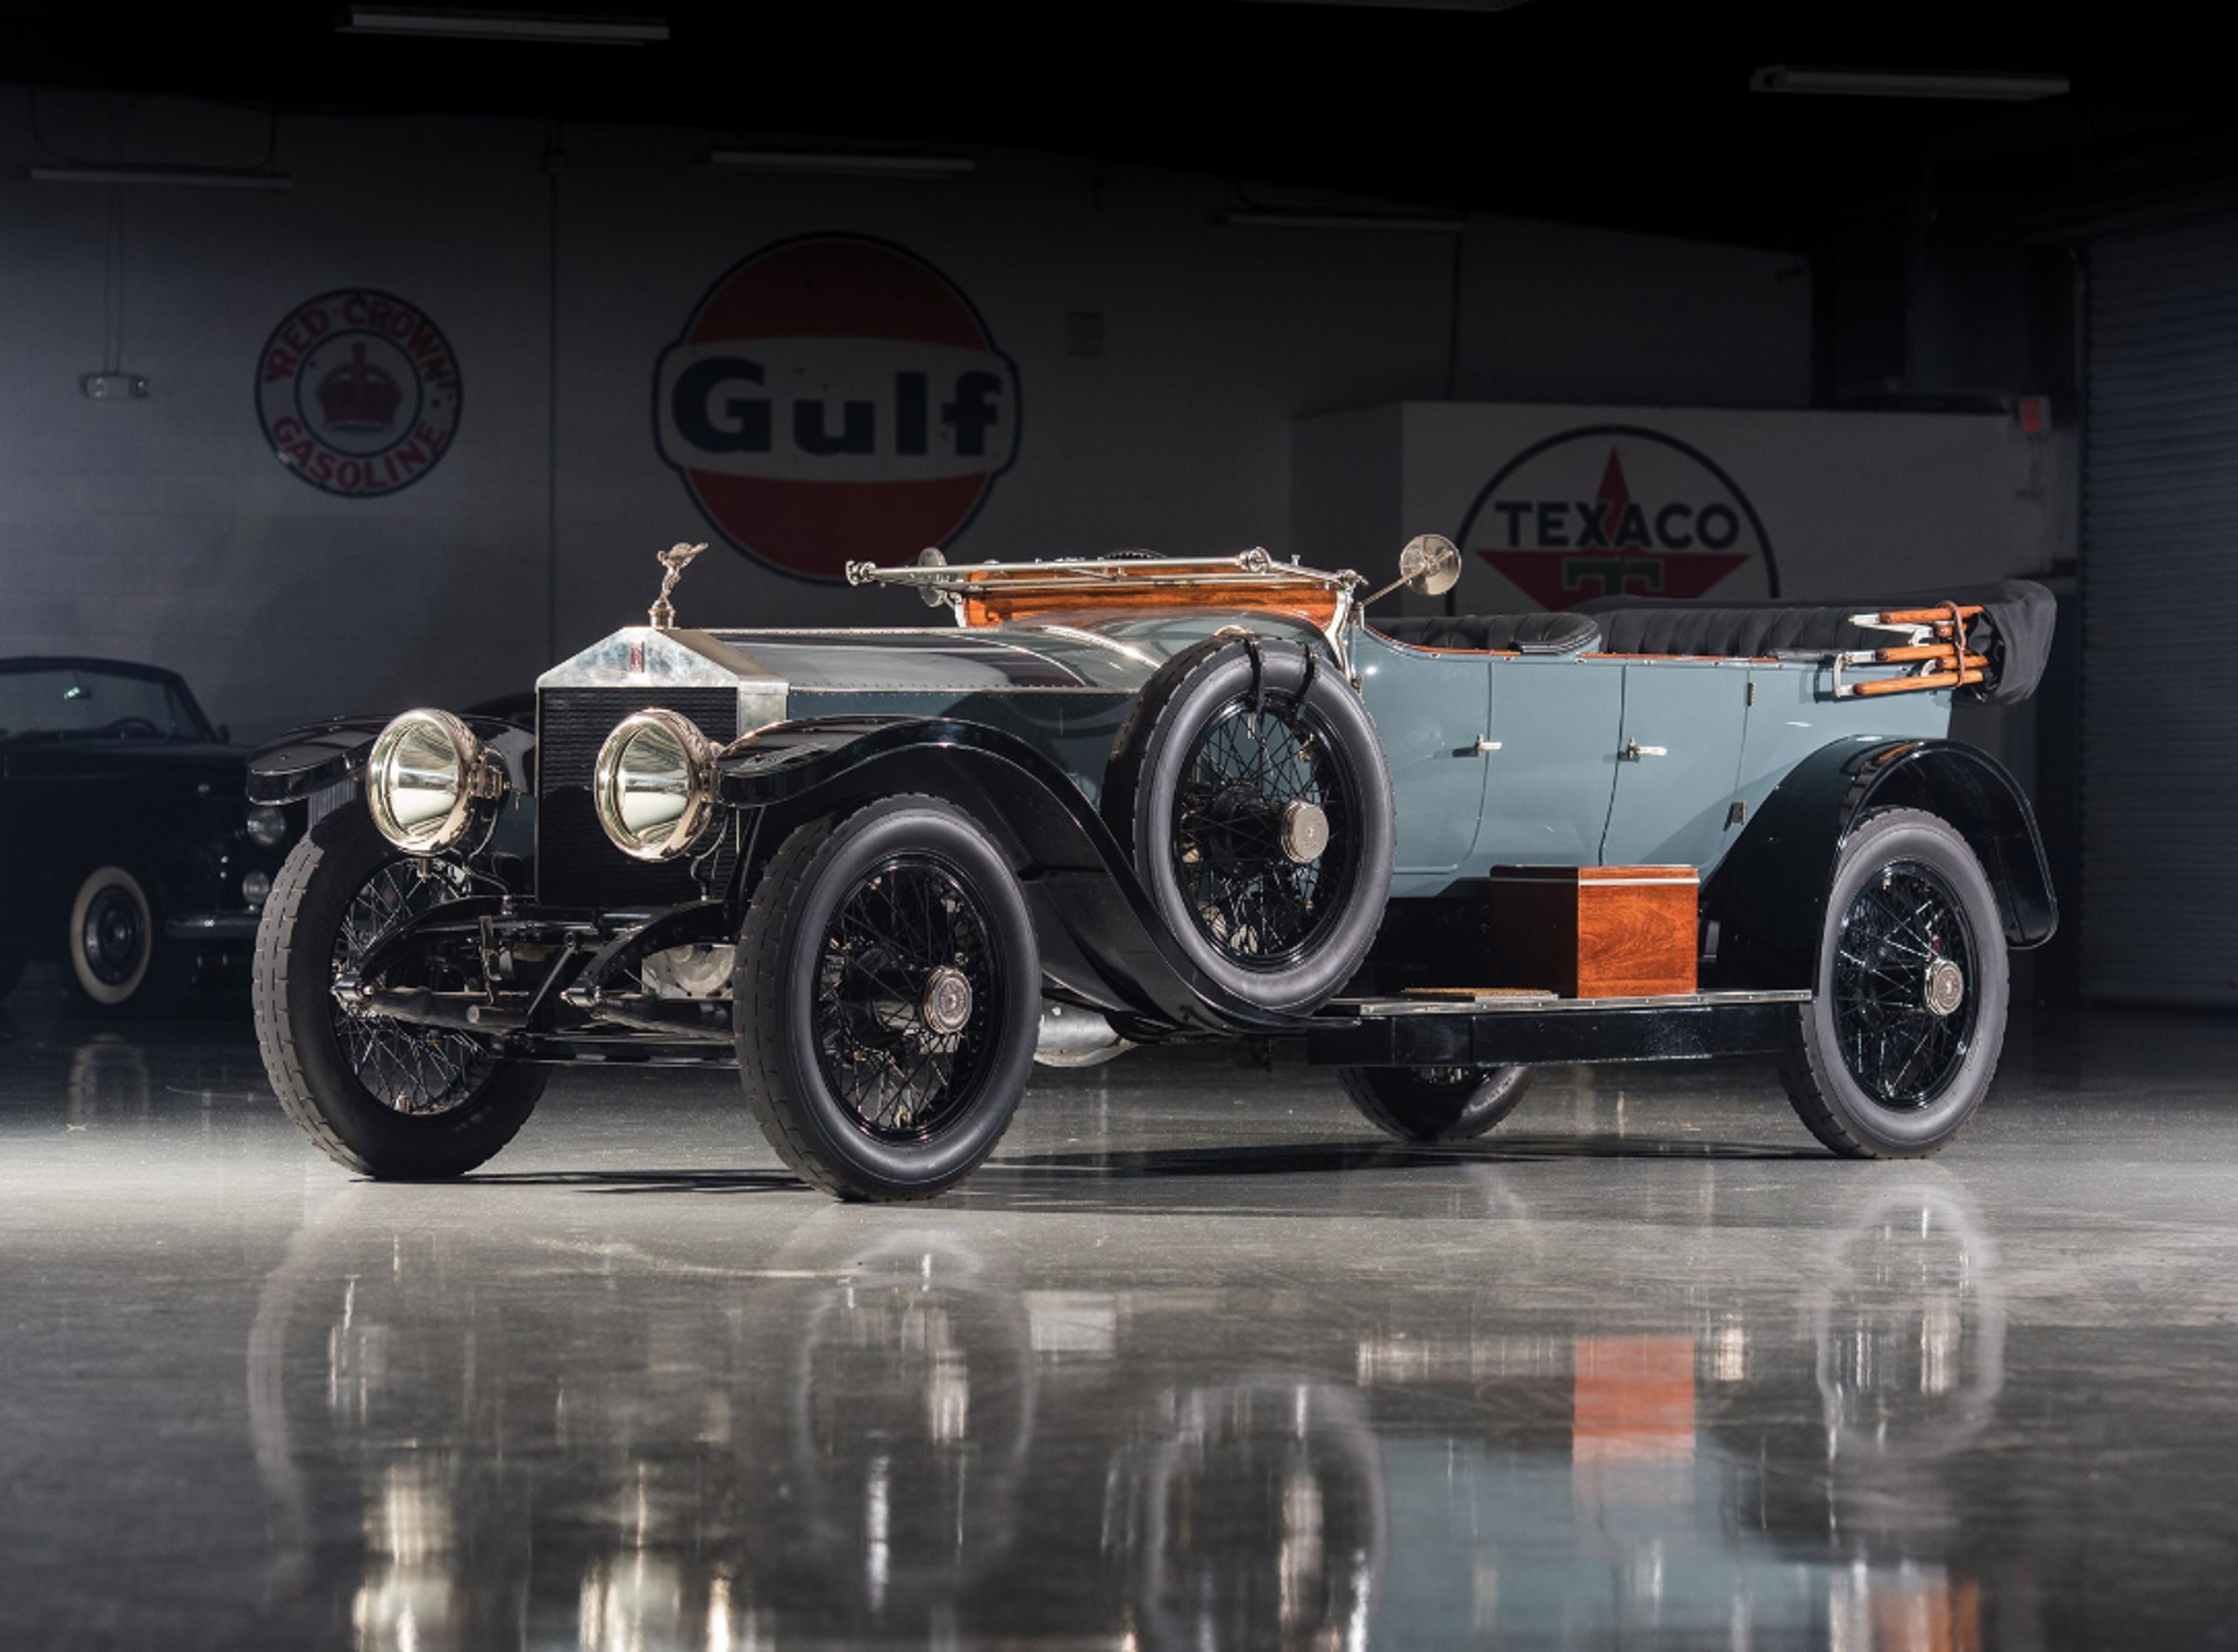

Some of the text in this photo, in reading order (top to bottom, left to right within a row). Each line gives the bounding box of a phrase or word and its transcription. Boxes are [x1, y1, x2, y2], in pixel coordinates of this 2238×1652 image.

[266, 297, 451, 381] RED CROWN
[672, 357, 1001, 455] Gulf
[273, 417, 446, 490] GASOLINE
[1496, 502, 1740, 549] TEXACO
